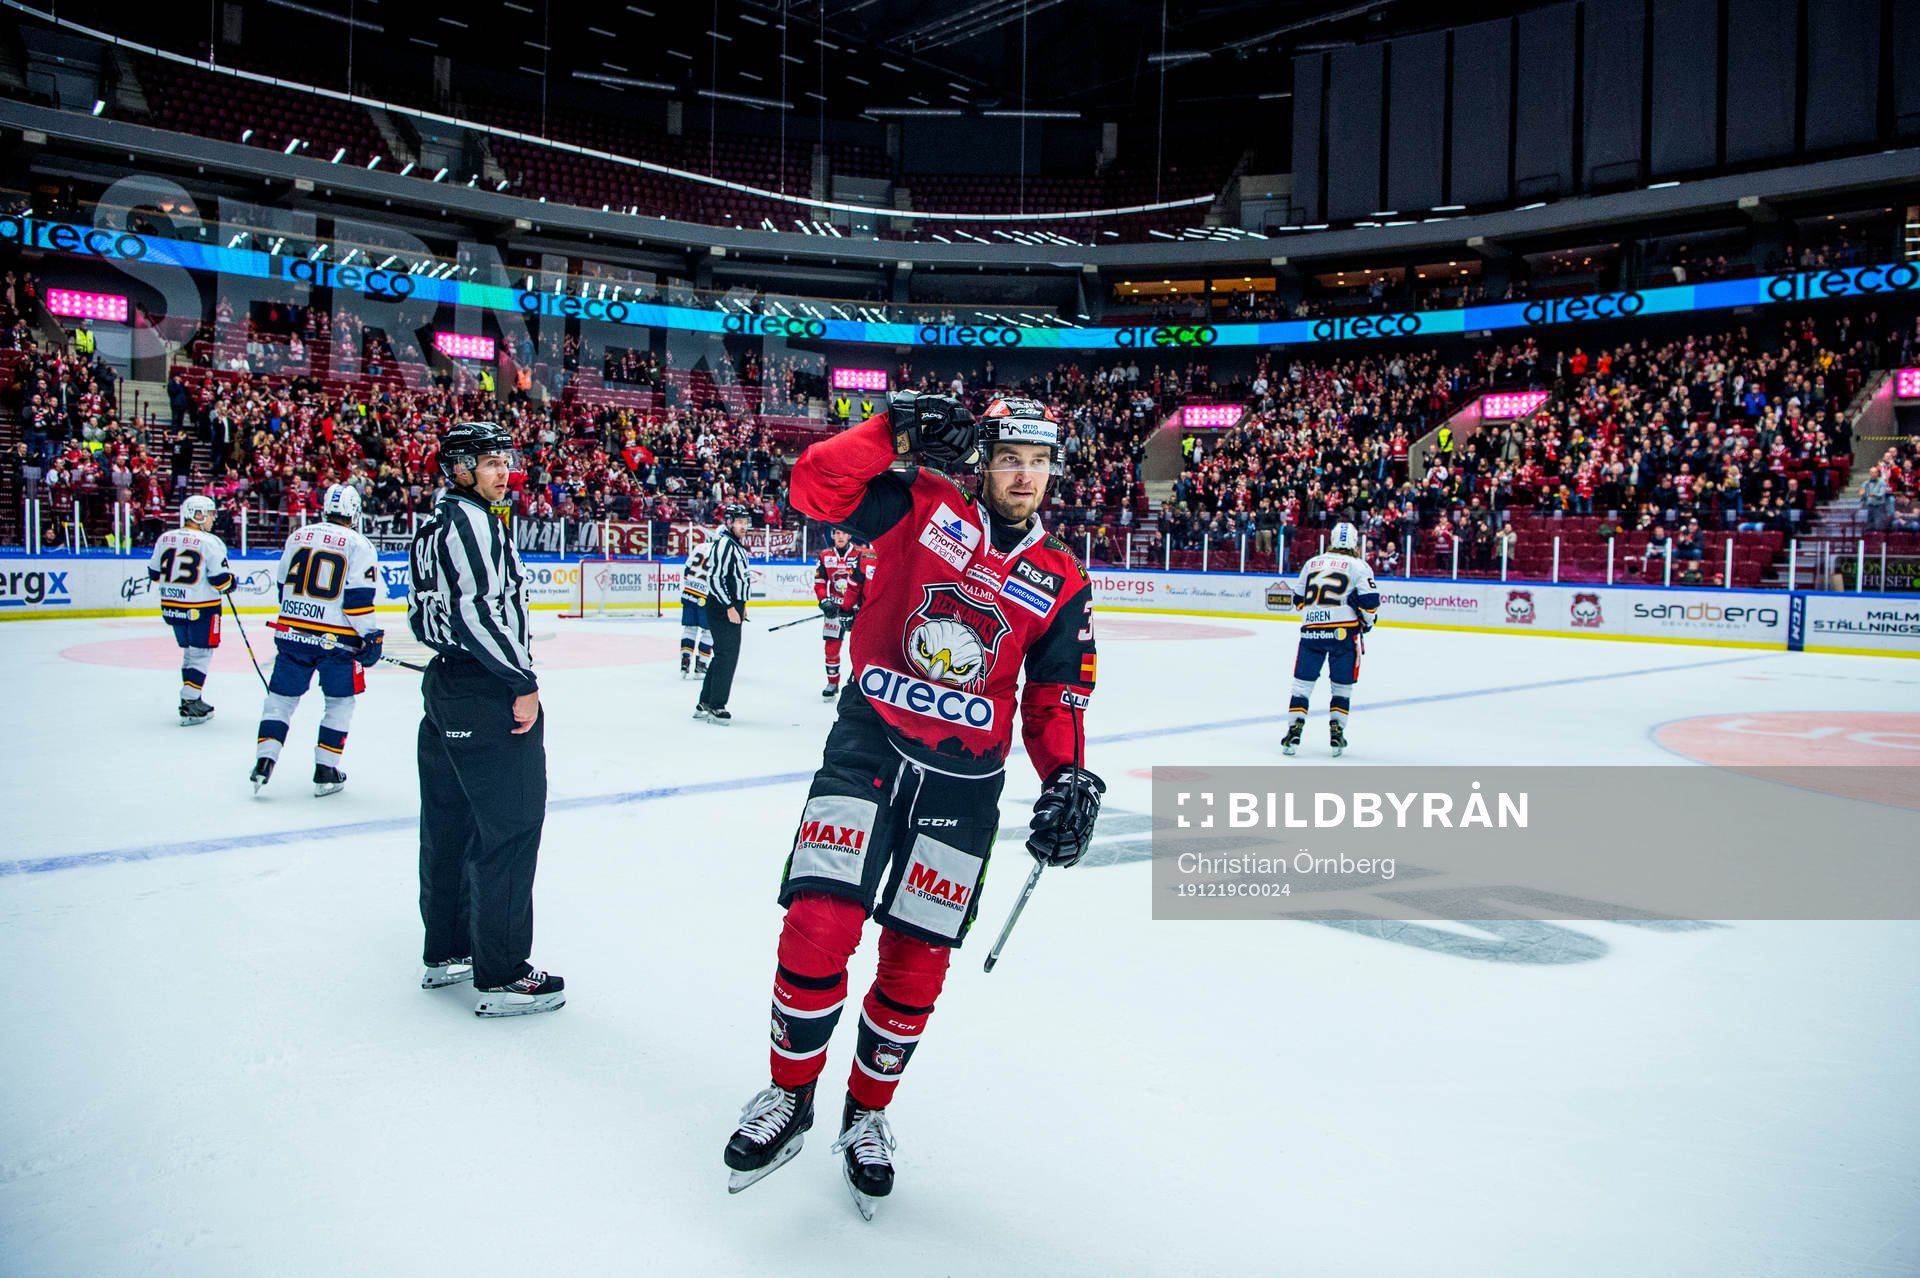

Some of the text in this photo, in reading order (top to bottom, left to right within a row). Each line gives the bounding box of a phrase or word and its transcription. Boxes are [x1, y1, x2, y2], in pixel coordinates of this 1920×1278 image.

[0, 212, 147, 260] areco
[290, 258, 416, 296] areco
[1768, 263, 1920, 301] areco
[519, 289, 629, 323] areco
[1523, 290, 1645, 326] areco
[722, 312, 827, 339] areco
[920, 322, 1022, 347] areco
[1115, 325, 1218, 348] areco
[1313, 312, 1422, 342] areco
[518, 520, 598, 553] MALÖ
[928, 527, 967, 559] Prioritet
[928, 538, 957, 564] Finans
[160, 547, 203, 585] 43
[284, 546, 348, 601] 40
[364, 565, 378, 583] 4
[611, 573, 642, 585] ROCK
[974, 563, 1002, 579] CCM
[1016, 561, 1054, 590] RSA
[281, 599, 326, 620] OSEFSON
[1007, 584, 1049, 611] EHRENBORG
[1380, 593, 1478, 610] ontagepunkten
[1634, 602, 1779, 627] sandberg
[860, 667, 993, 728] areco
[445, 730, 473, 738] CCM
[800, 820, 865, 849] MAXI
[917, 818, 959, 827] CCM
[803, 841, 861, 856] STORMARKNAD
[908, 862, 972, 905] MAXI
[917, 890, 965, 912] STORMARKNAD
[887, 1019, 917, 1031] CCM
